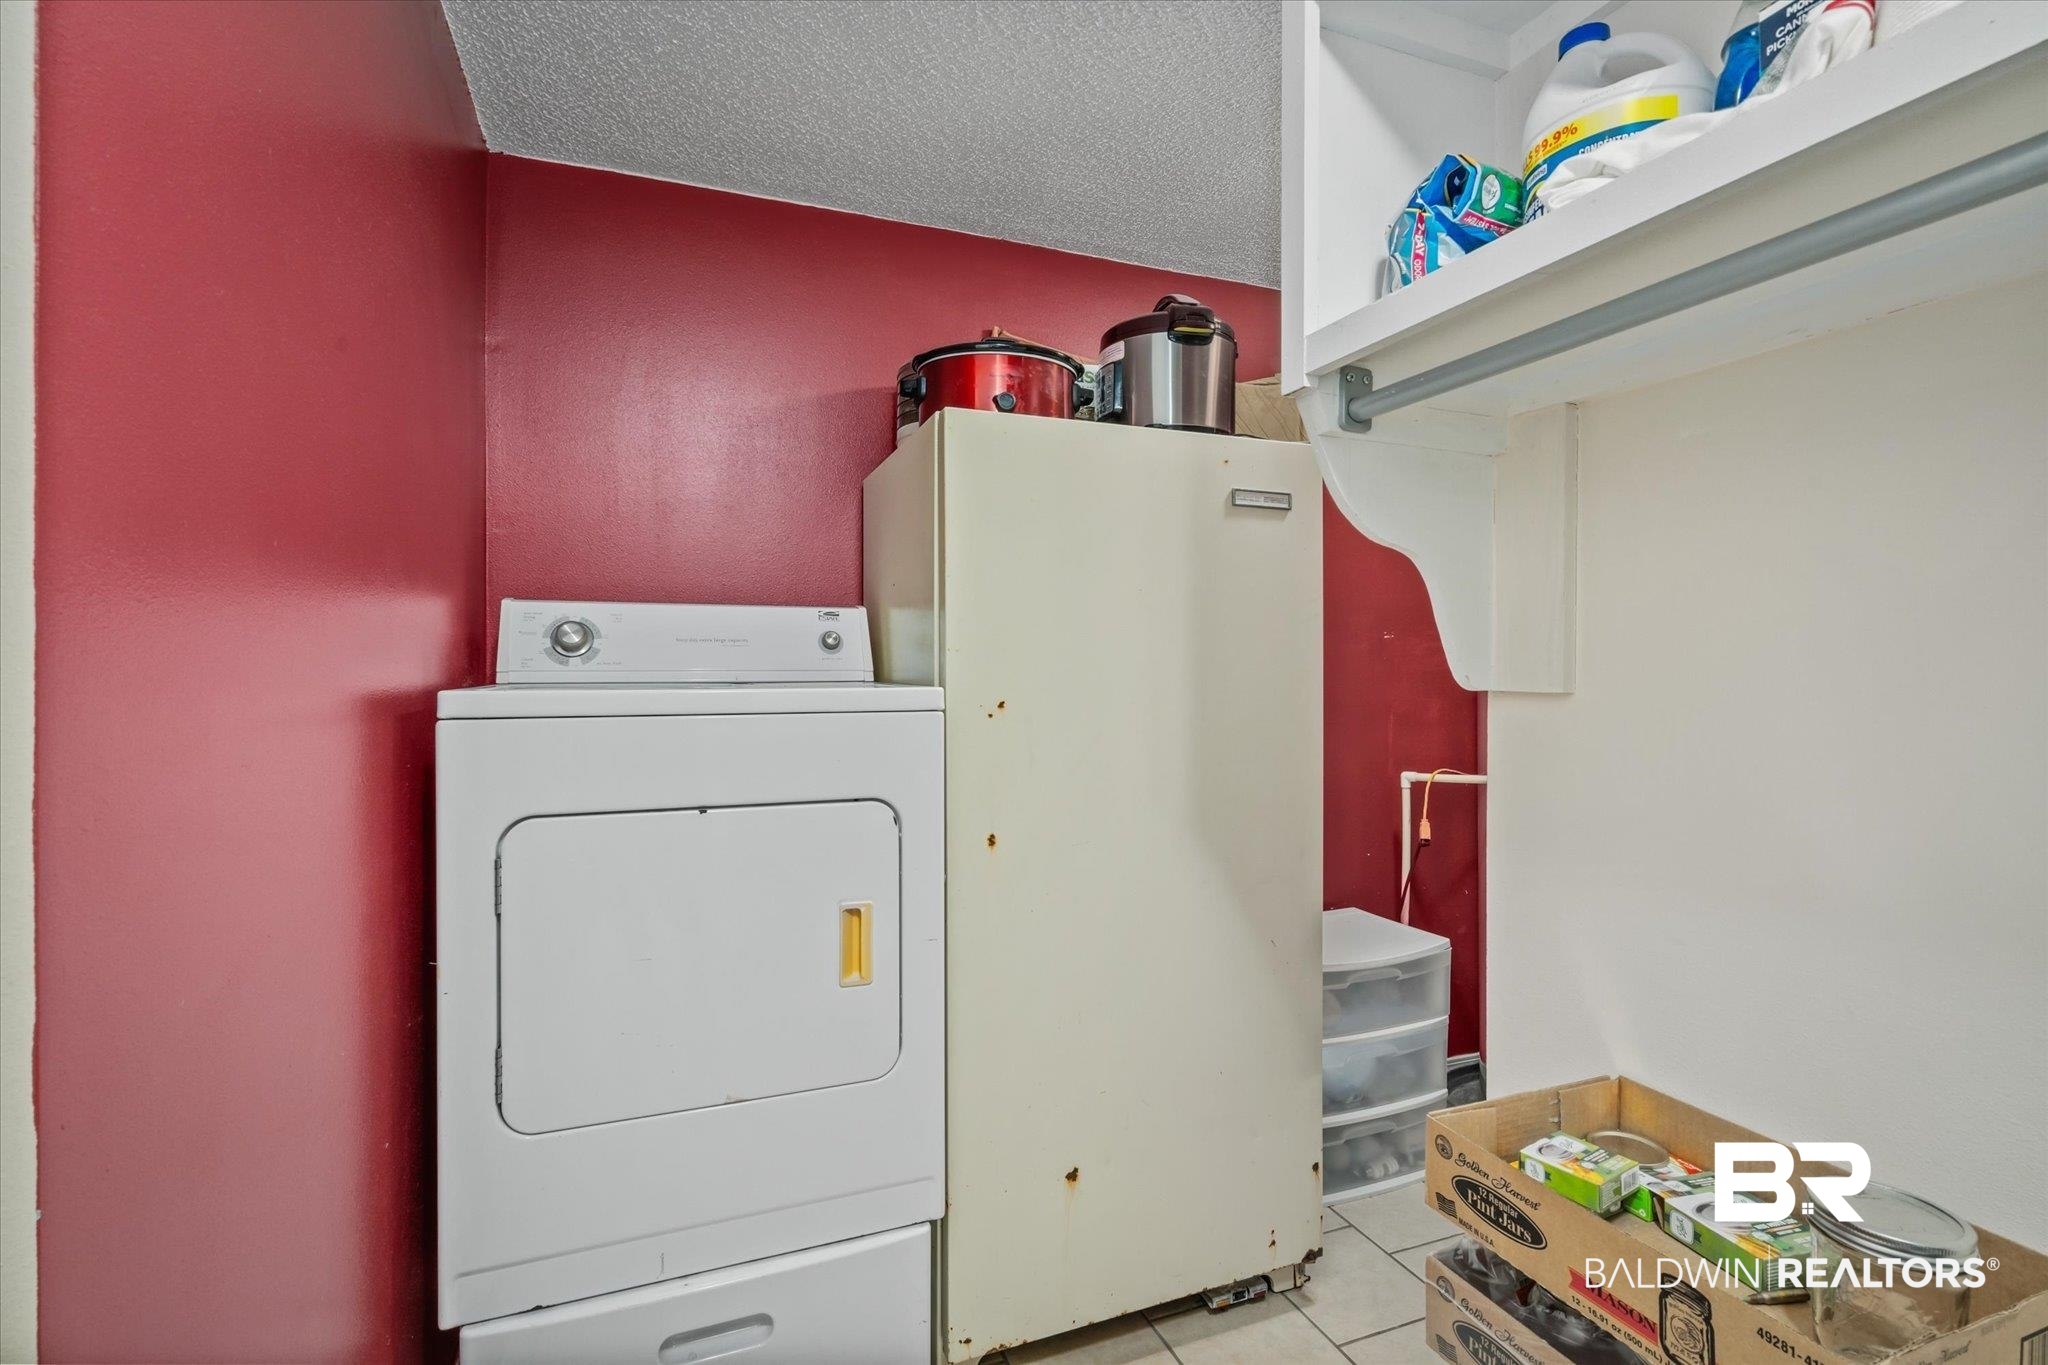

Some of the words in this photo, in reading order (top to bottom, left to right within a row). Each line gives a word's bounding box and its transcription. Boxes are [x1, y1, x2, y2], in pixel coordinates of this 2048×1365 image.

[1534, 122, 1578, 159] 99.9%
[1455, 1152, 1490, 1181] Golden
[1491, 1177, 1541, 1211] Harvest
[1467, 1188, 1498, 1221] Pint
[1498, 1210, 1533, 1244] Jars
[1479, 1187, 1488, 1200] 12
[1489, 1193, 1518, 1220] Regular
[1458, 1217, 1473, 1233] MADE
[1456, 1298, 1493, 1331] Golden
[1495, 1329, 1545, 1365] Harve
[1571, 1295, 1581, 1307] 12
[1588, 1306, 1609, 1326] 16.91
[1611, 1323, 1622, 1335] oz
[1756, 1327, 1825, 1365] 49281-41
